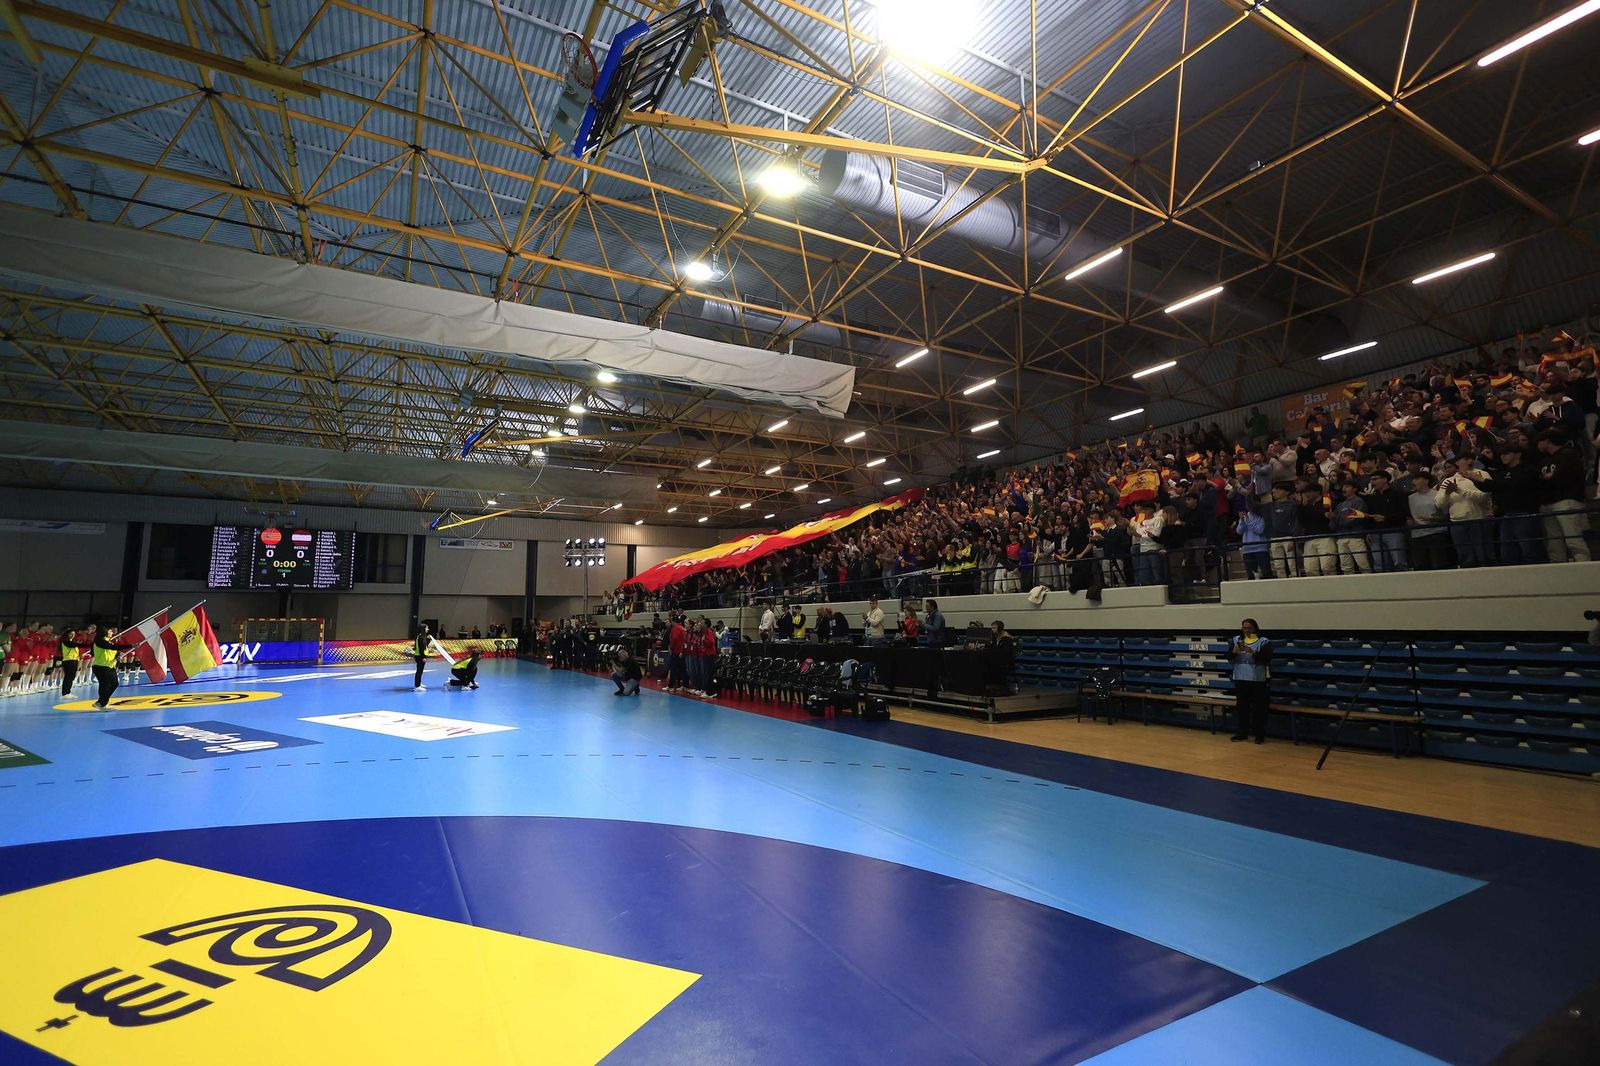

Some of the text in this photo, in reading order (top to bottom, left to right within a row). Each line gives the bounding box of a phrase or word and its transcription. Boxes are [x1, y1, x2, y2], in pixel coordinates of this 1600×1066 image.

[1303, 392, 1329, 405] Bar
[266, 549, 274, 558] 0
[296, 550, 305, 559] 0
[273, 560, 297, 568] 0:00
